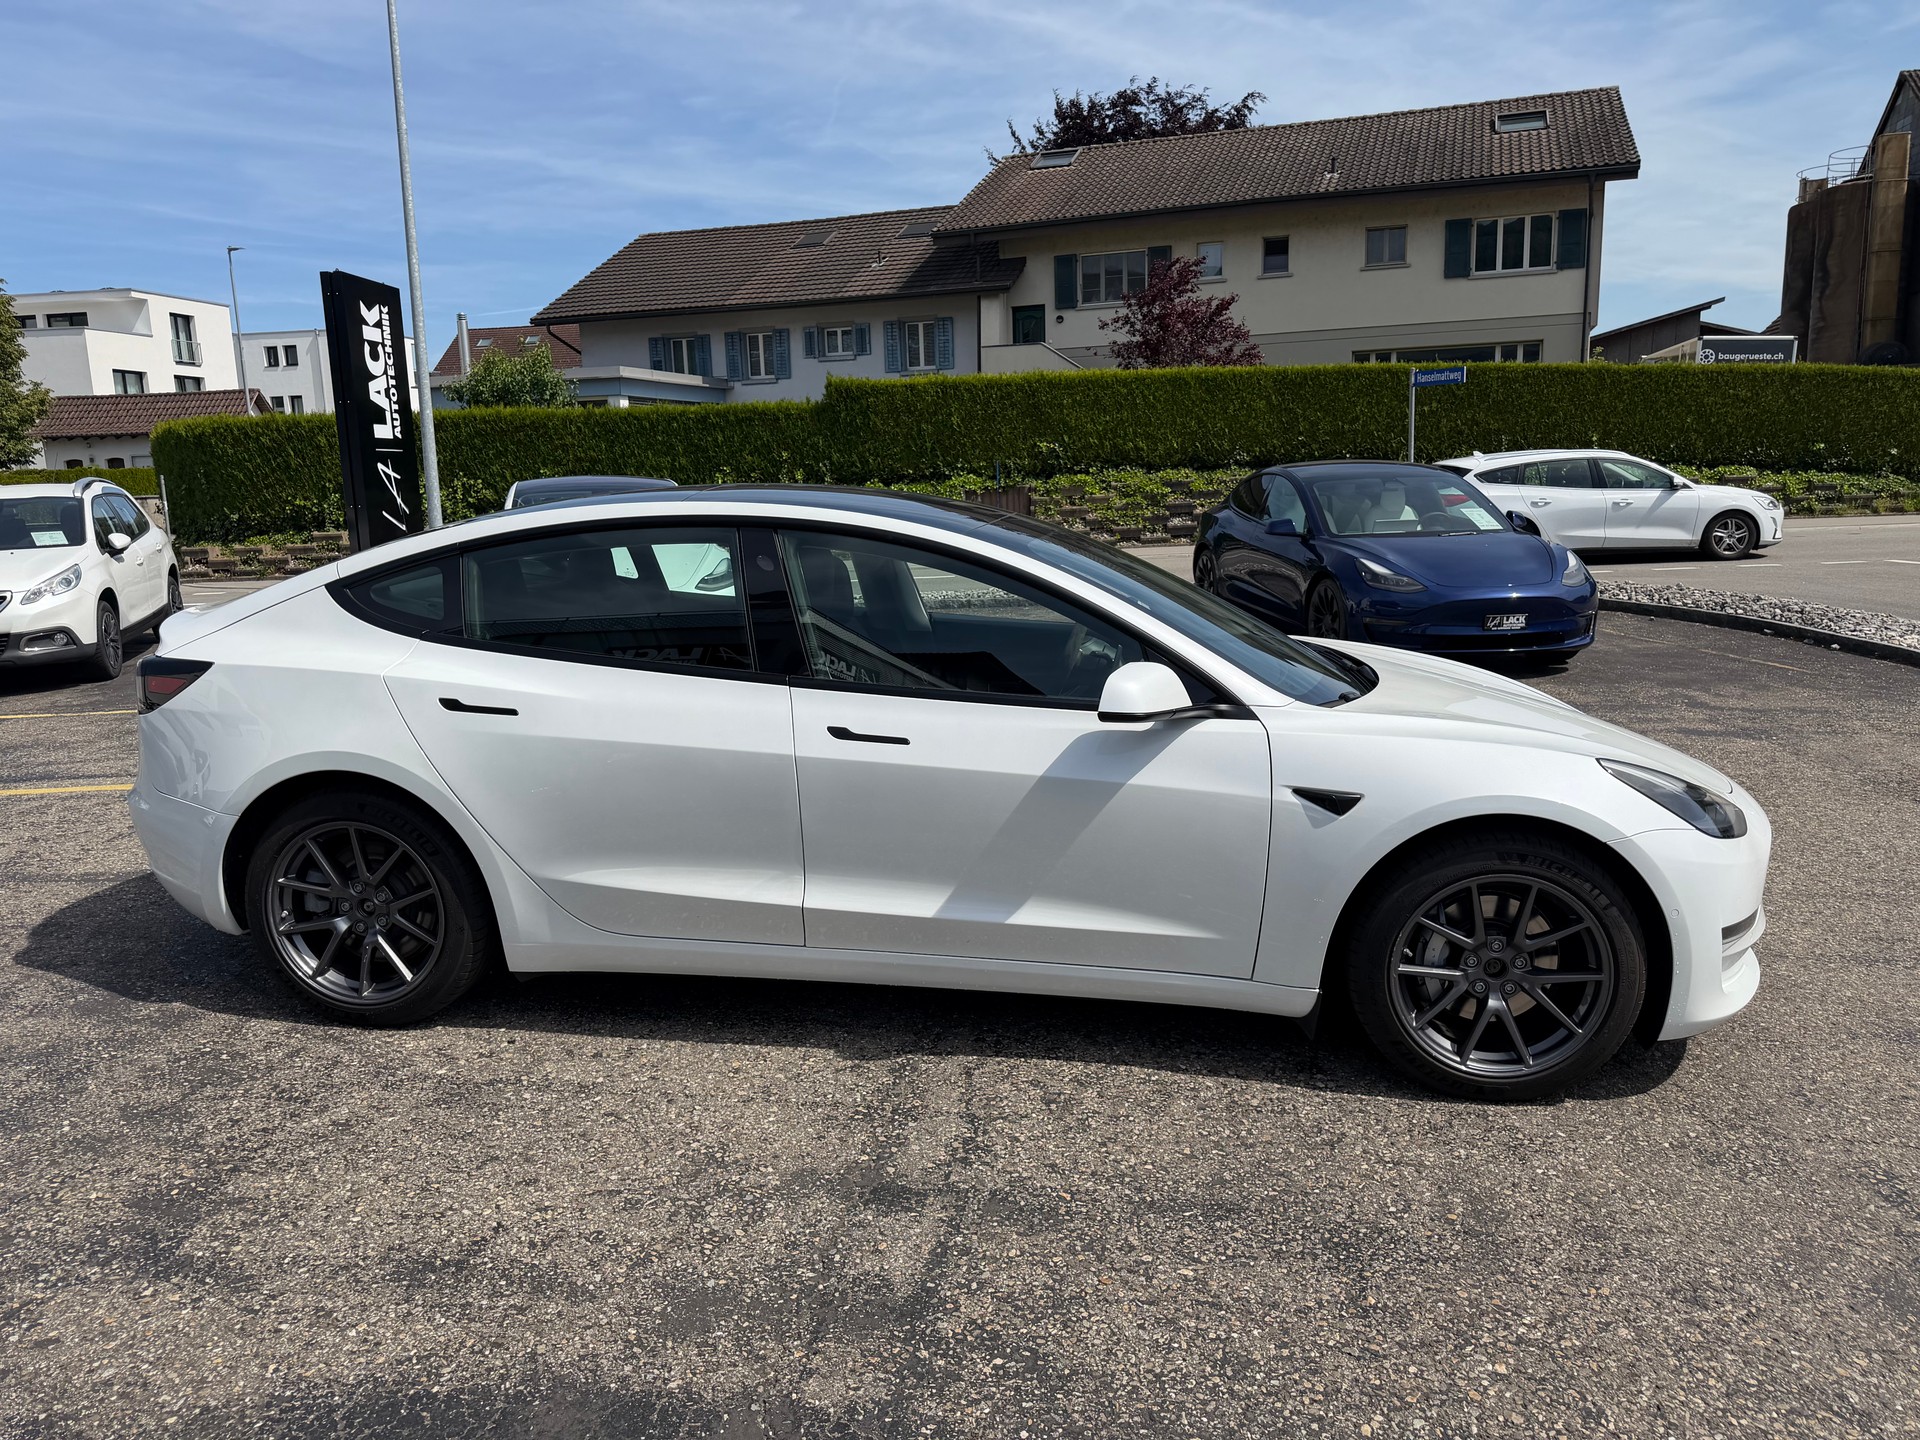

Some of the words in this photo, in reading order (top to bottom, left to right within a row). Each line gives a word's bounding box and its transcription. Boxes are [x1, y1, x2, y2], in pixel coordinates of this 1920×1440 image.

[359, 300, 394, 440] LACK
[380, 304, 403, 439] AUTOTECHNIK
[1718, 352, 1784, 361] baugerueste.ch
[1503, 615, 1526, 624] LACK
